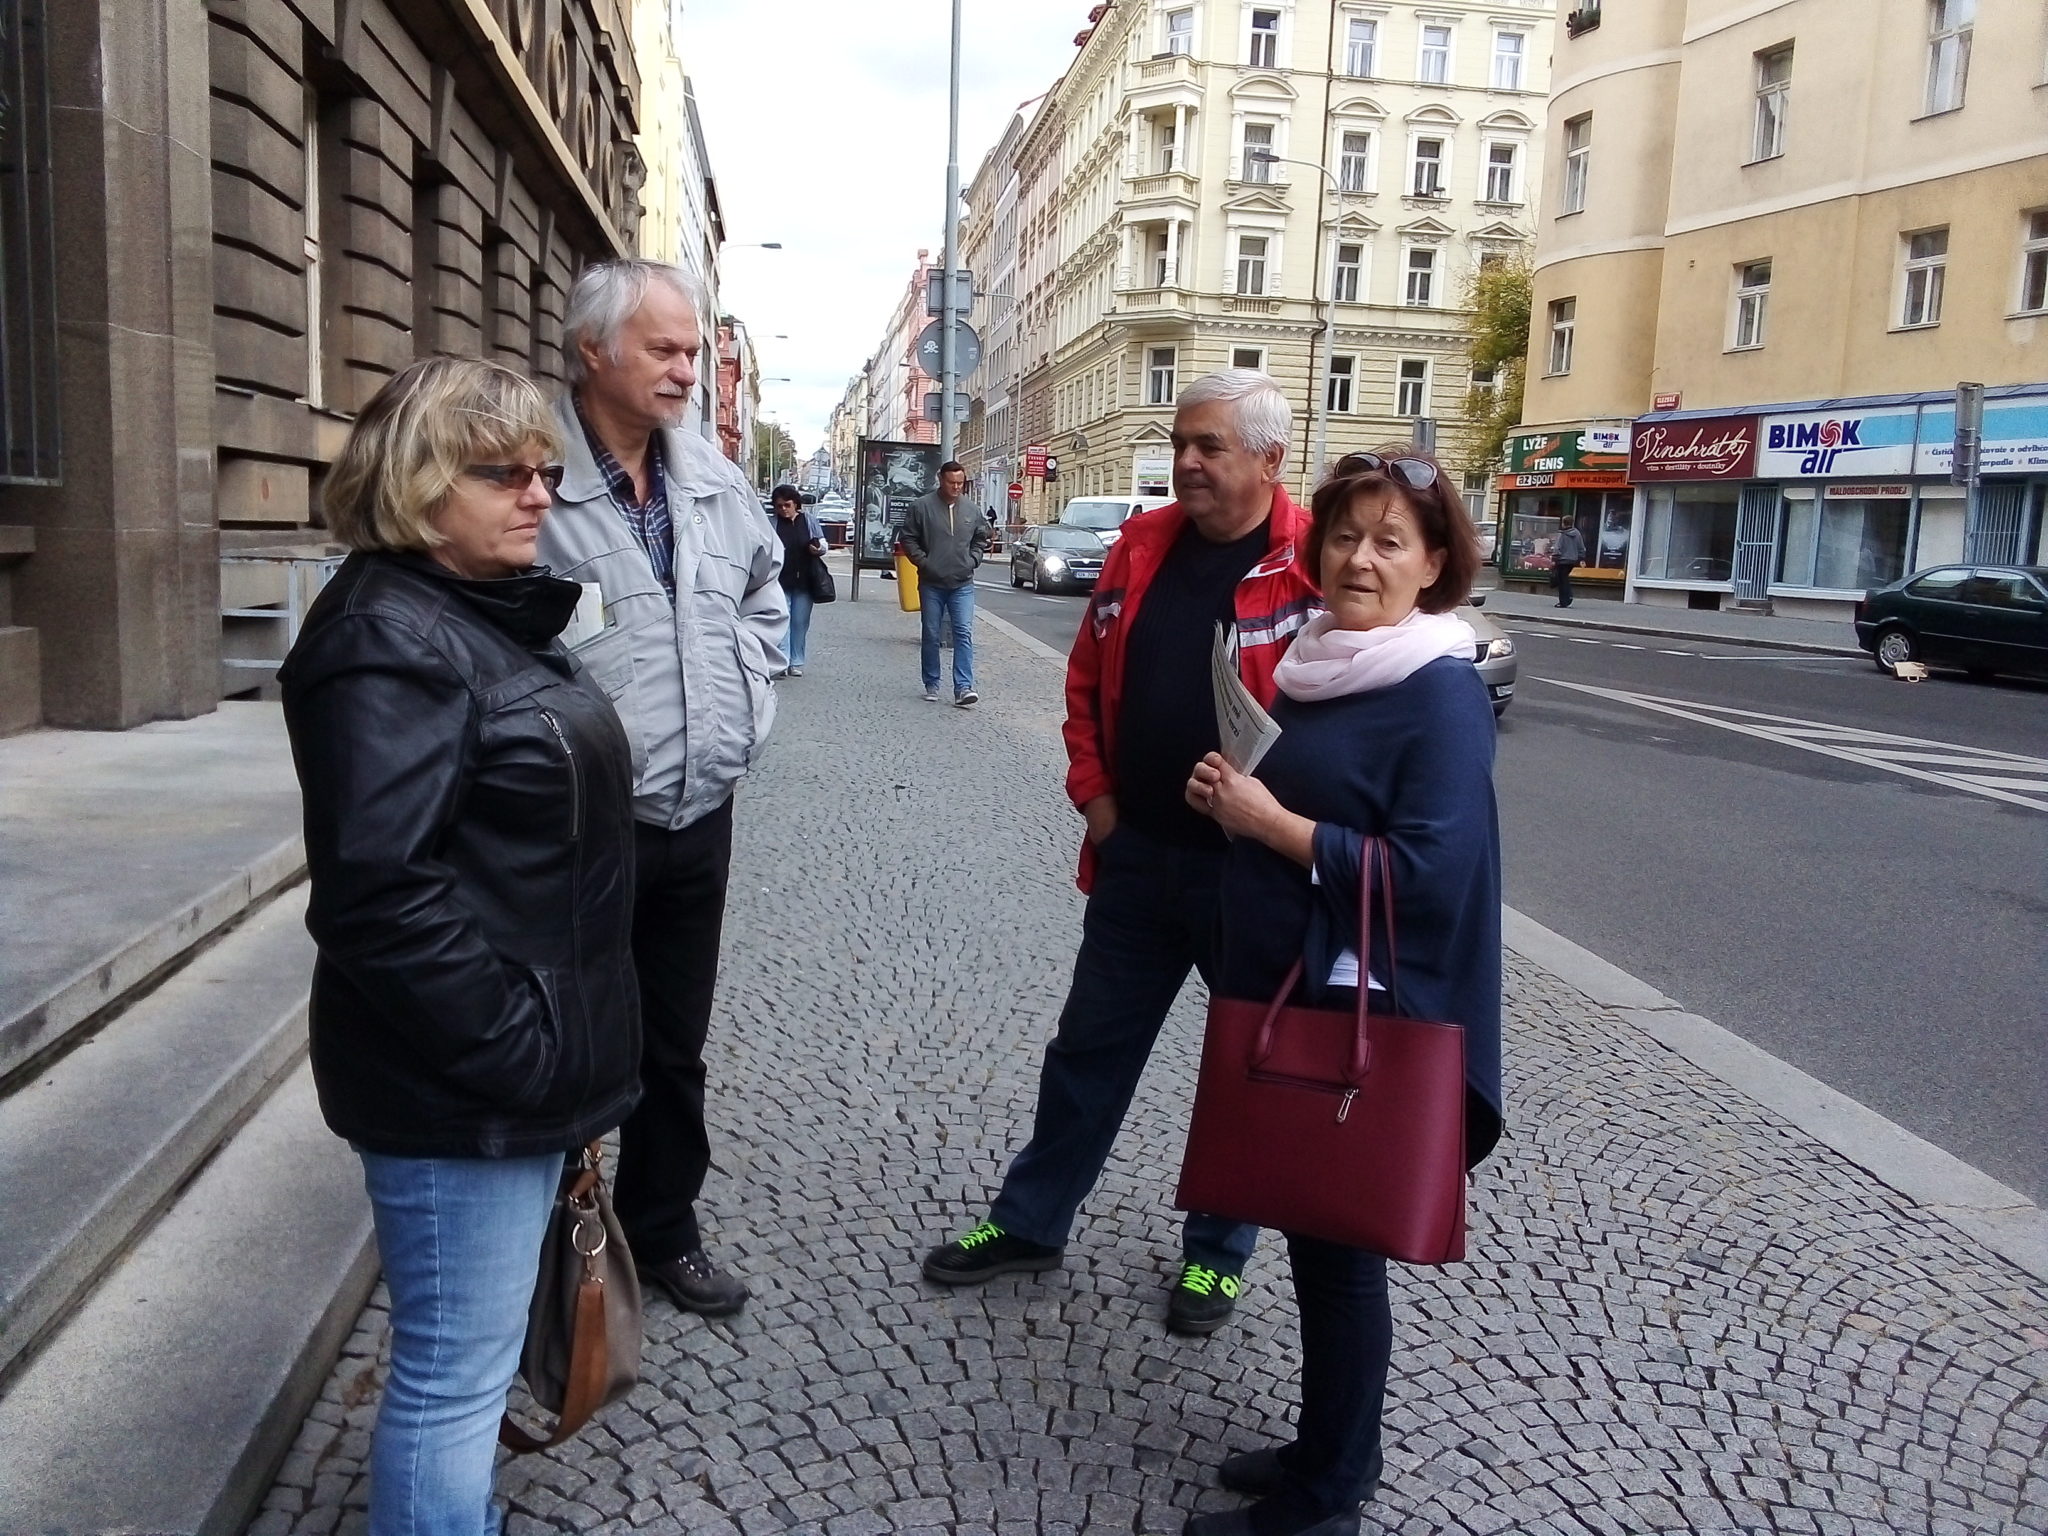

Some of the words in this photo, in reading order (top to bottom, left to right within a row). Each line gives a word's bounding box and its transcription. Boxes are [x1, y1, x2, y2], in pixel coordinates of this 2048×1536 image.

[1593, 432, 1619, 441] BIMOK
[1768, 419, 1862, 449] BIMOK
[1523, 435, 1548, 451] LYŽE
[1636, 427, 1751, 474] Vinohrátky
[1534, 457, 1564, 470] TENIS
[1800, 448, 1842, 474] air
[1880, 485, 1907, 495] PRODEJ
